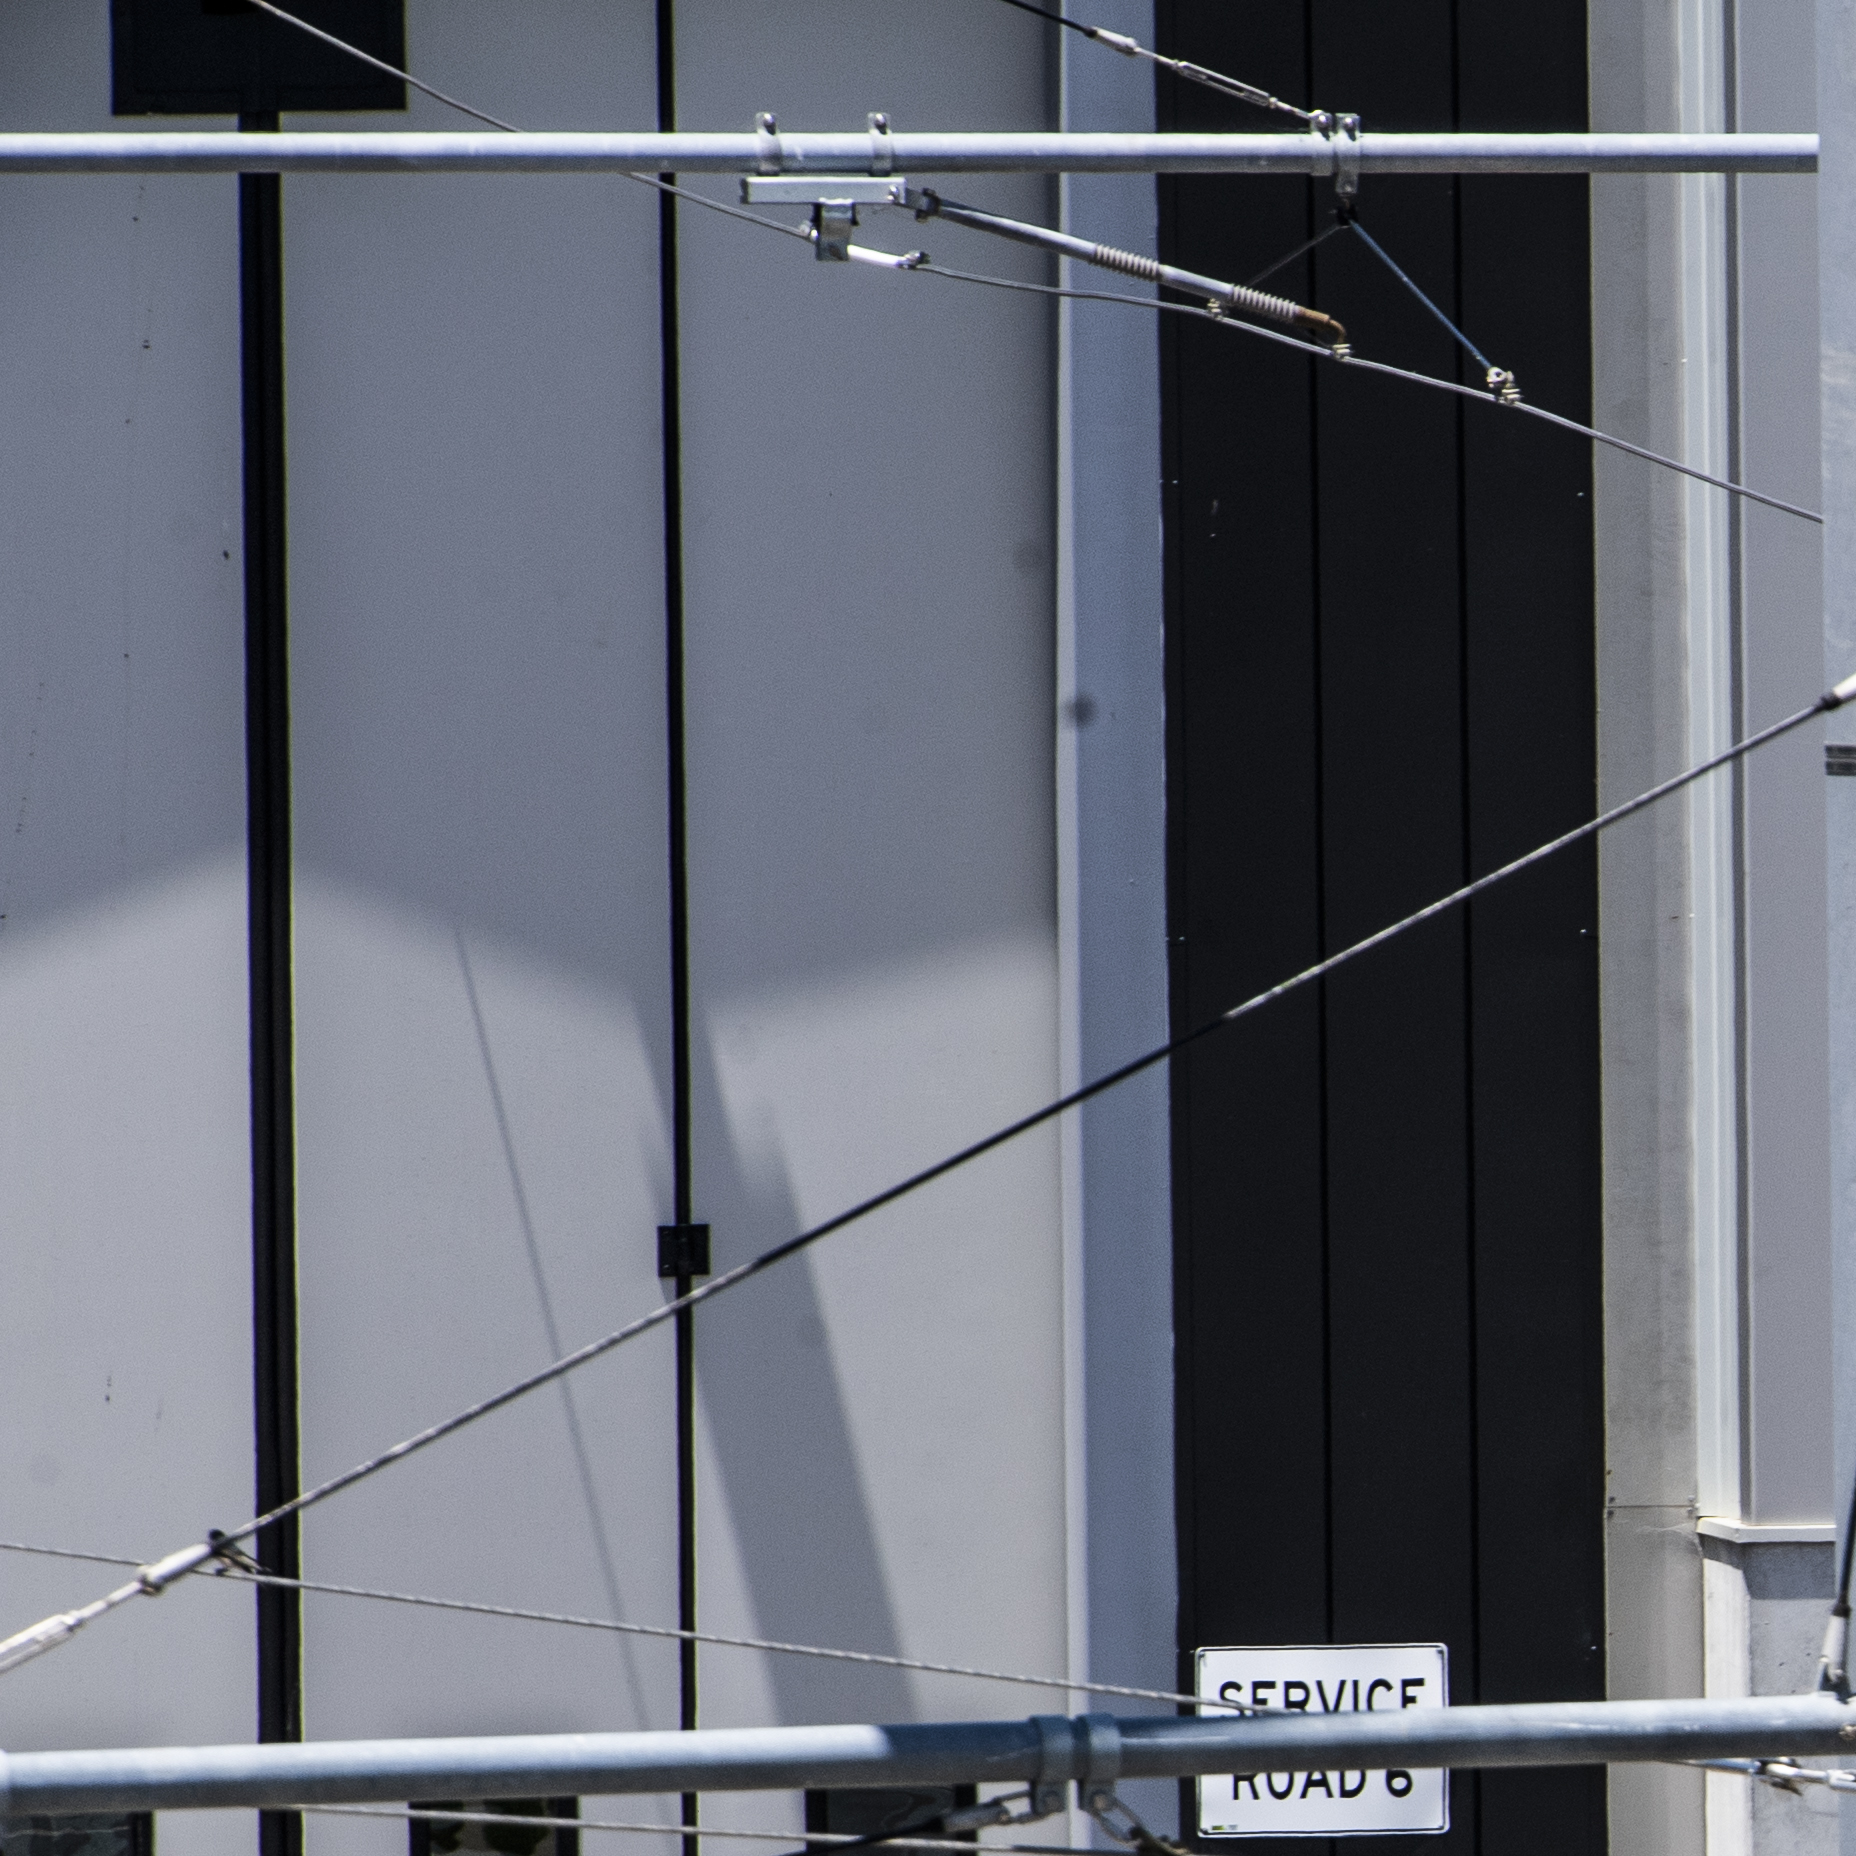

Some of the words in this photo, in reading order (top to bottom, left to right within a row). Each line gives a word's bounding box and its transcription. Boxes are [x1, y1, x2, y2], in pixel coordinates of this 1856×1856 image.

[1219, 1677, 1426, 1716] SERVICE
[1232, 1770, 1367, 1800] ROAD
[1385, 1769, 1414, 1799] 6
